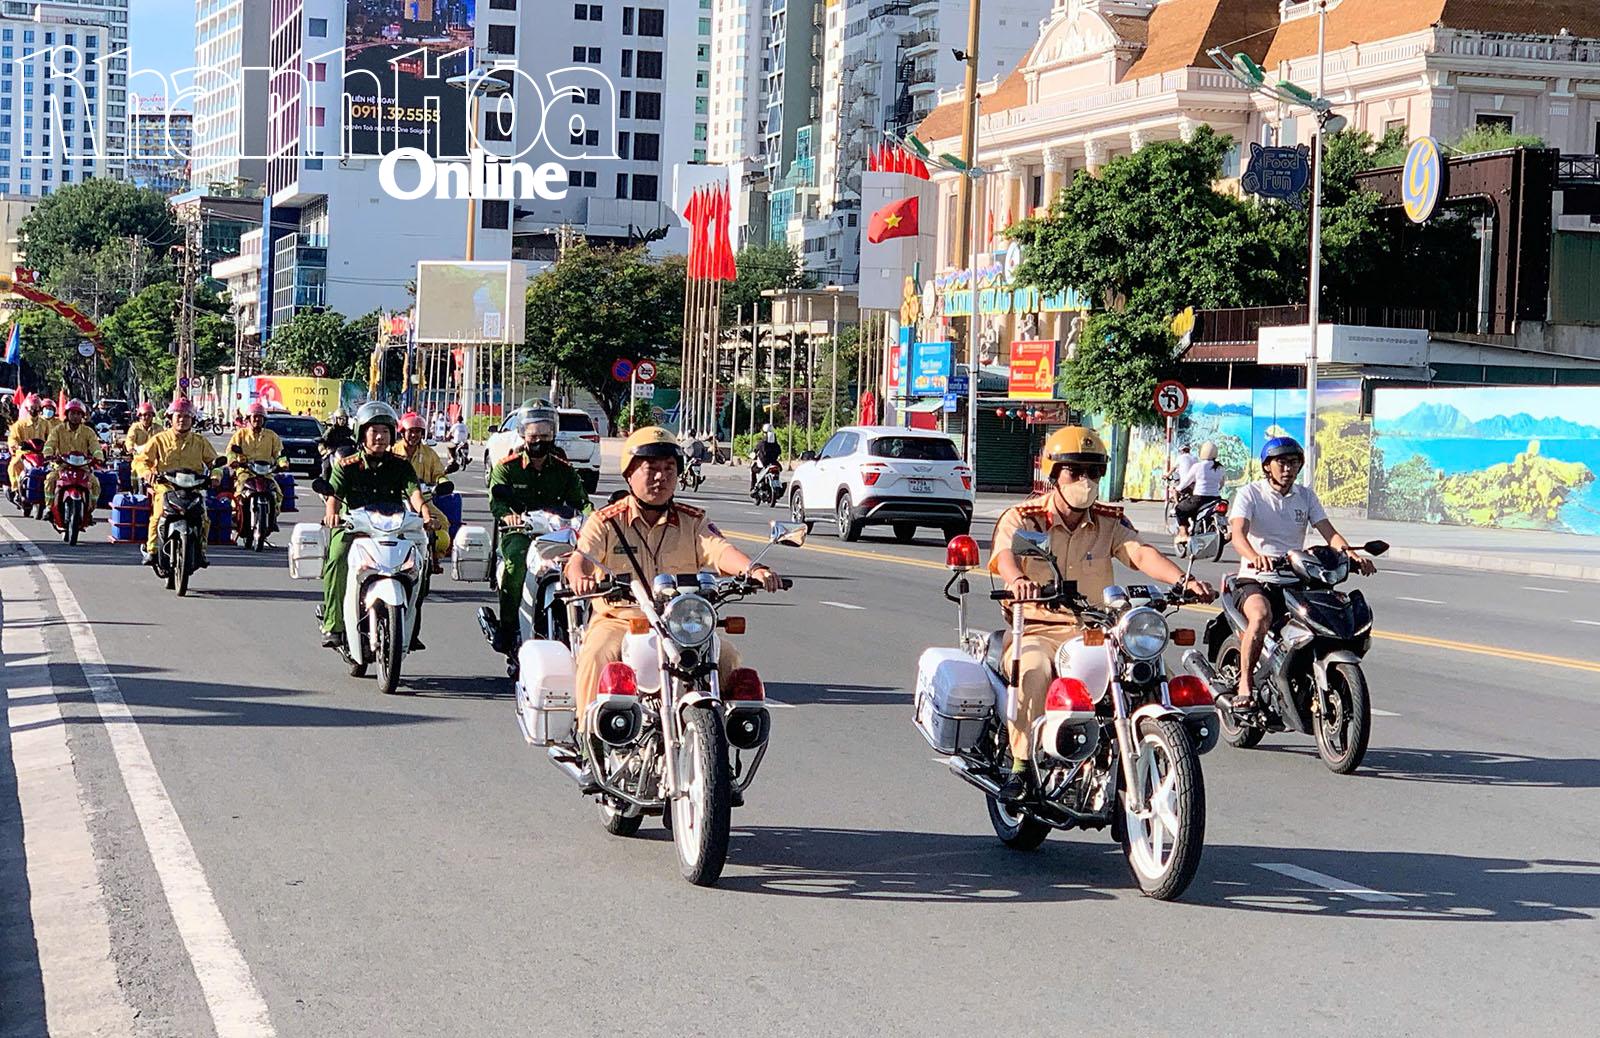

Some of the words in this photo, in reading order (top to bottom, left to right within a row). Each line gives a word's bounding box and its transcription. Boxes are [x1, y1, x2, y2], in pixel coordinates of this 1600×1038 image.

[1263, 153, 1299, 169] Food
[1262, 170, 1291, 190] Fun
[294, 386, 329, 396] maxm
